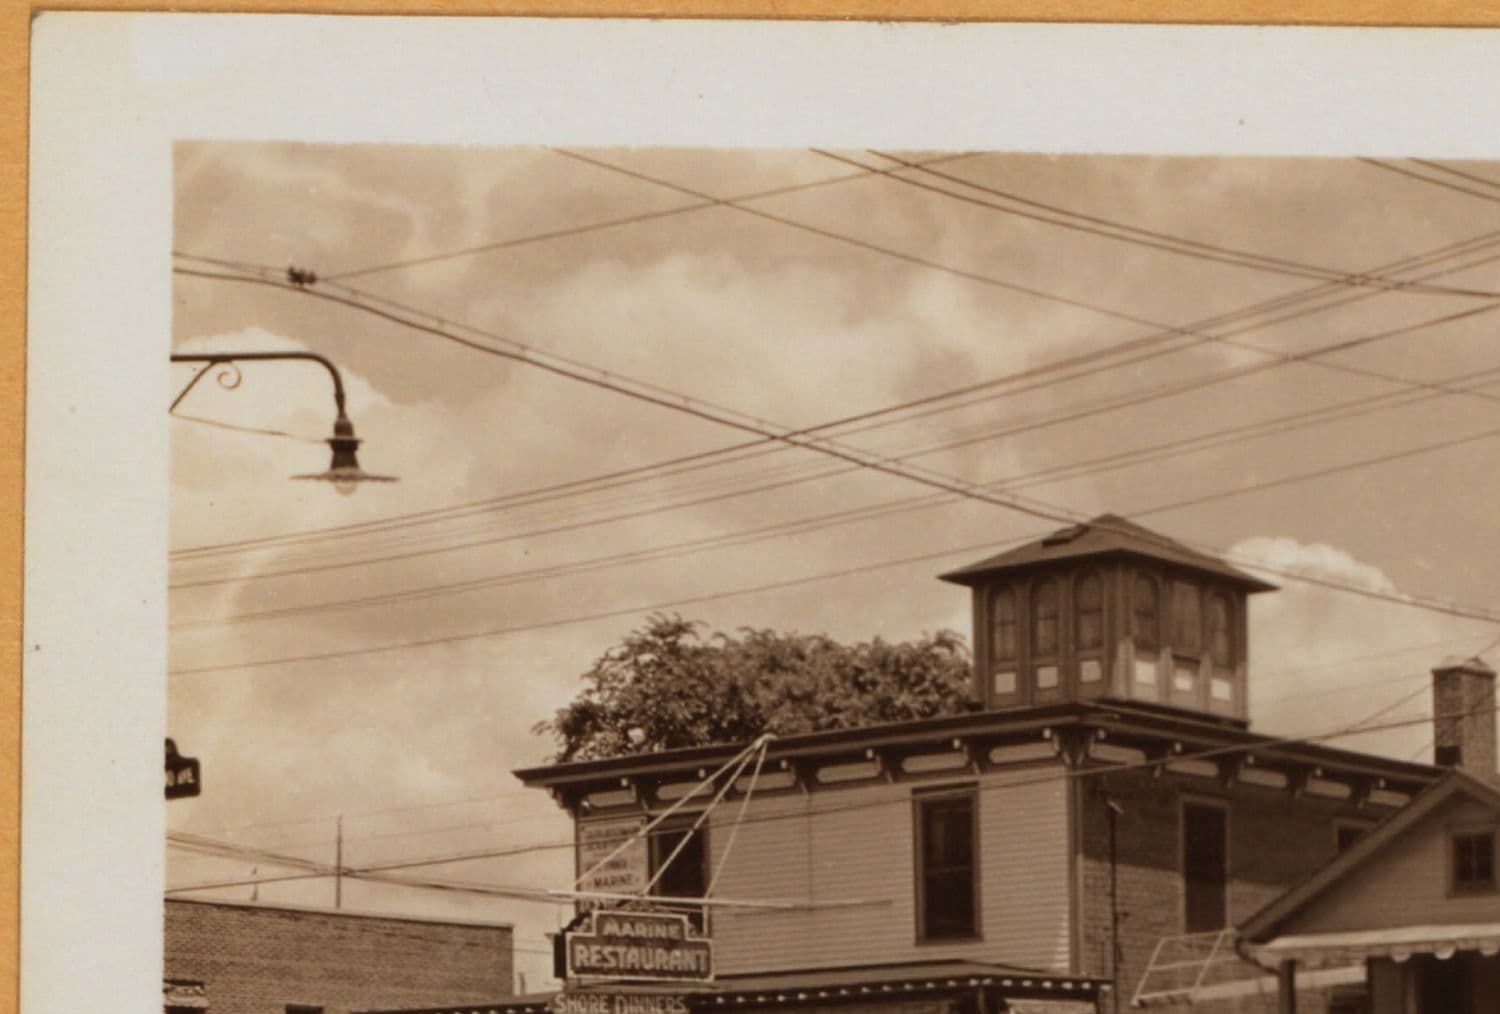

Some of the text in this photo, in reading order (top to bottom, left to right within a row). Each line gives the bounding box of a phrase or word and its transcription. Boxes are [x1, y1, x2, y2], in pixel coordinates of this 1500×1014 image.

[602, 918, 681, 939] MARINE
[575, 945, 708, 972] RESTAURANT
[553, 992, 610, 1014] SHORE
